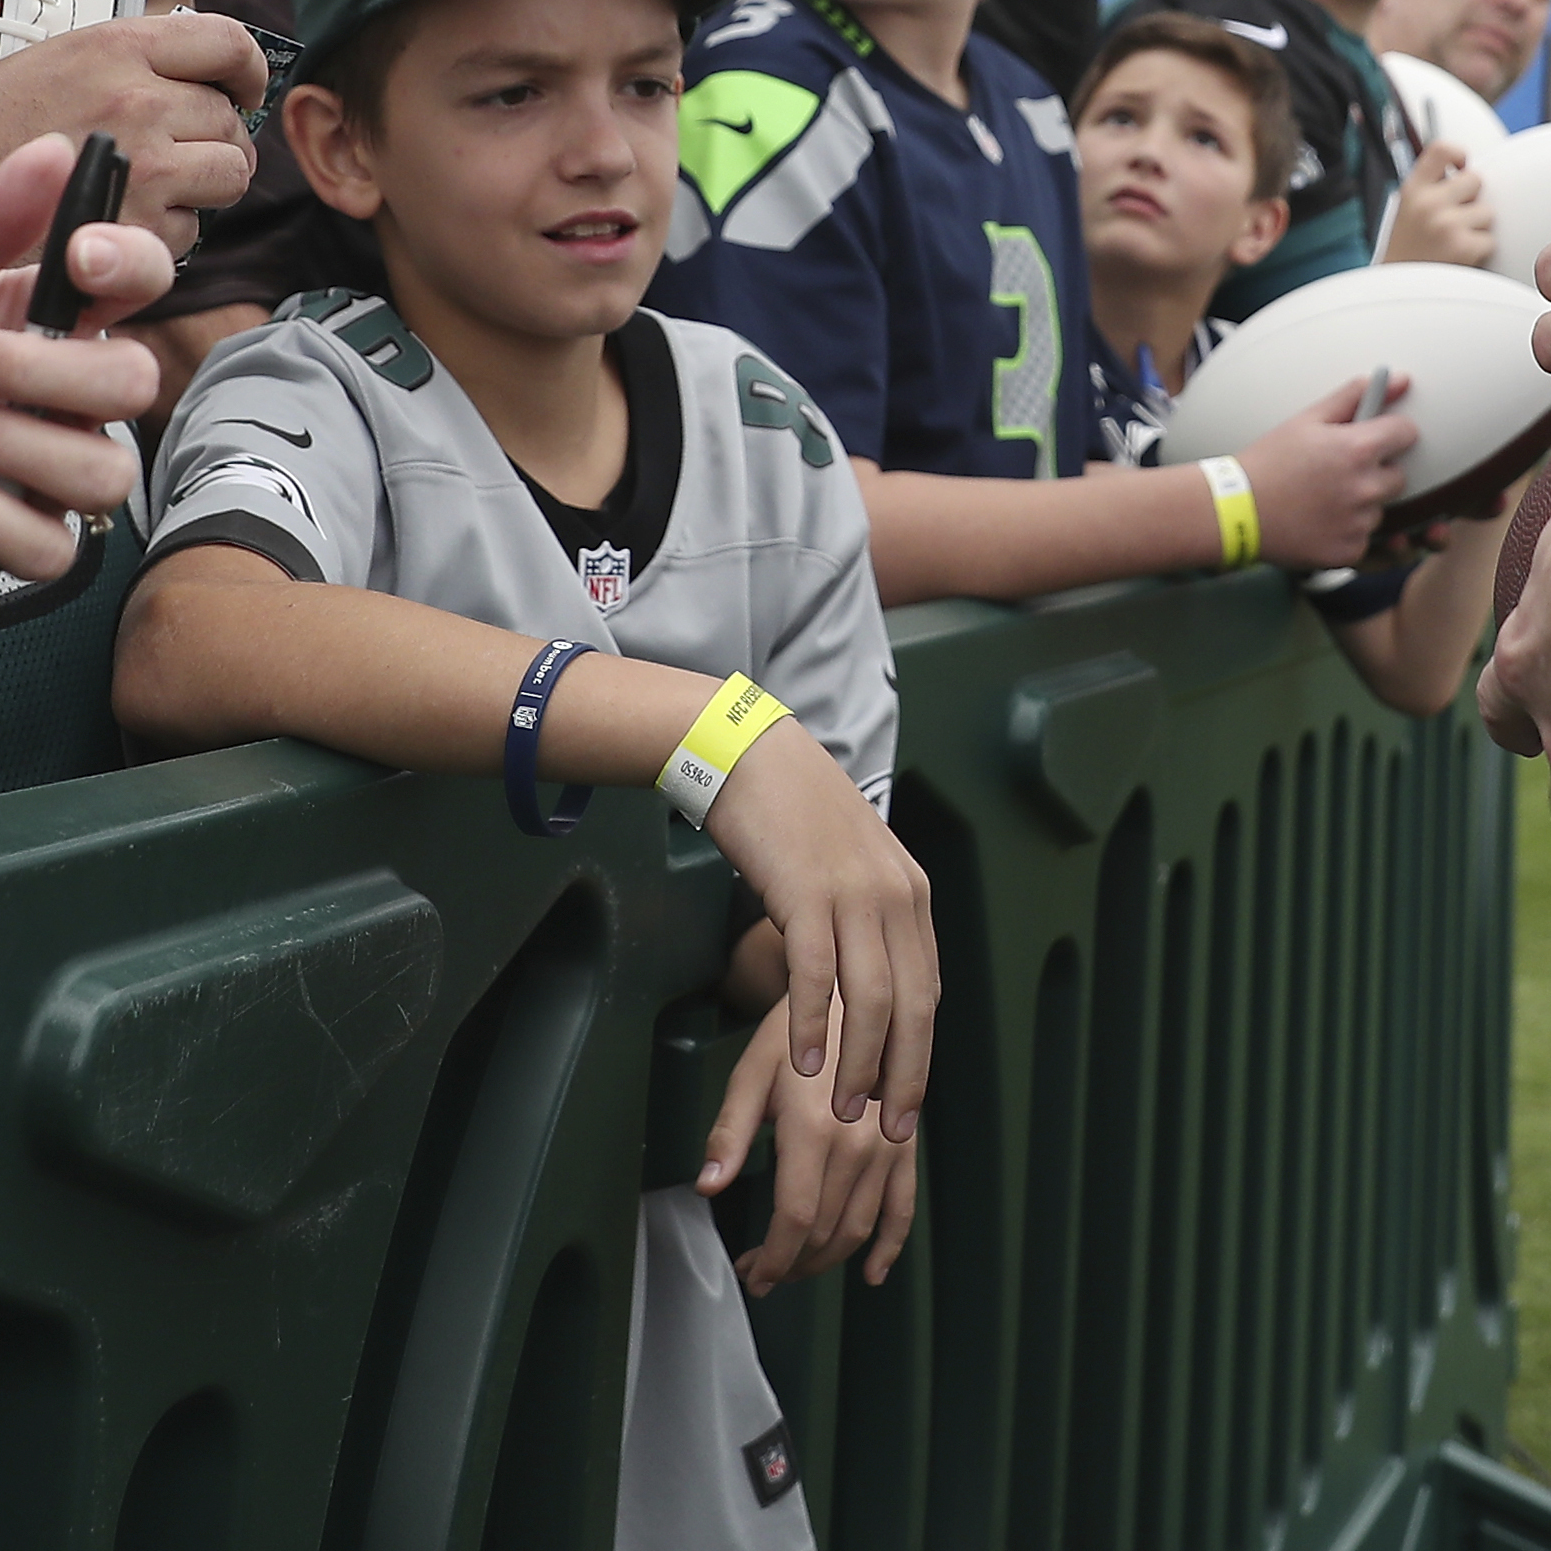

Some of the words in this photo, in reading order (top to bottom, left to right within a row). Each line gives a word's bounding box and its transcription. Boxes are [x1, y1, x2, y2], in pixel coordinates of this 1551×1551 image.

[985, 221, 1063, 479] 3
[590, 576, 622, 604] NFL
[532, 648, 561, 686] number
[726, 701, 749, 726] NFC
